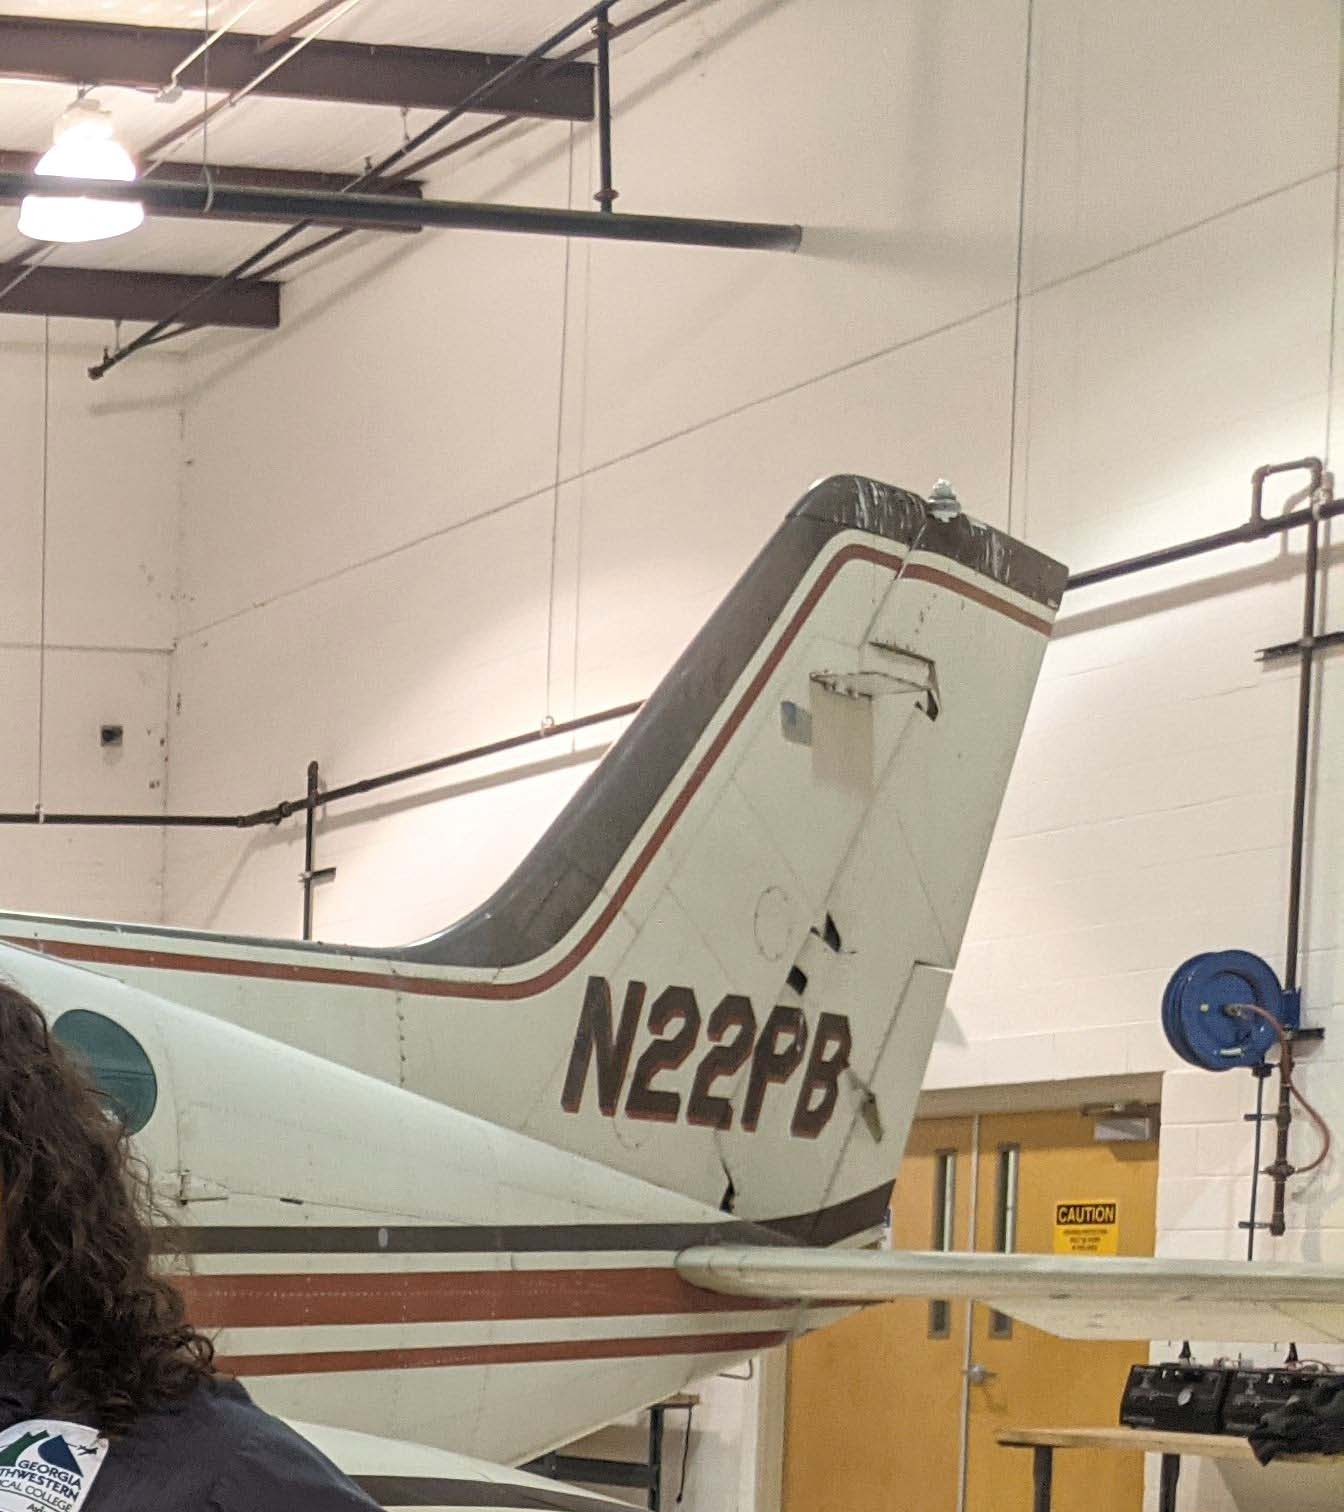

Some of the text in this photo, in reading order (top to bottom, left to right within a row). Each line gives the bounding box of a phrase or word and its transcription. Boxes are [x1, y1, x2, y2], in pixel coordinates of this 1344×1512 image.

[560, 974, 853, 1140] N22PB
[1058, 1206, 1114, 1223] CAUTION
[17, 1459, 82, 1491] GEORGIA
